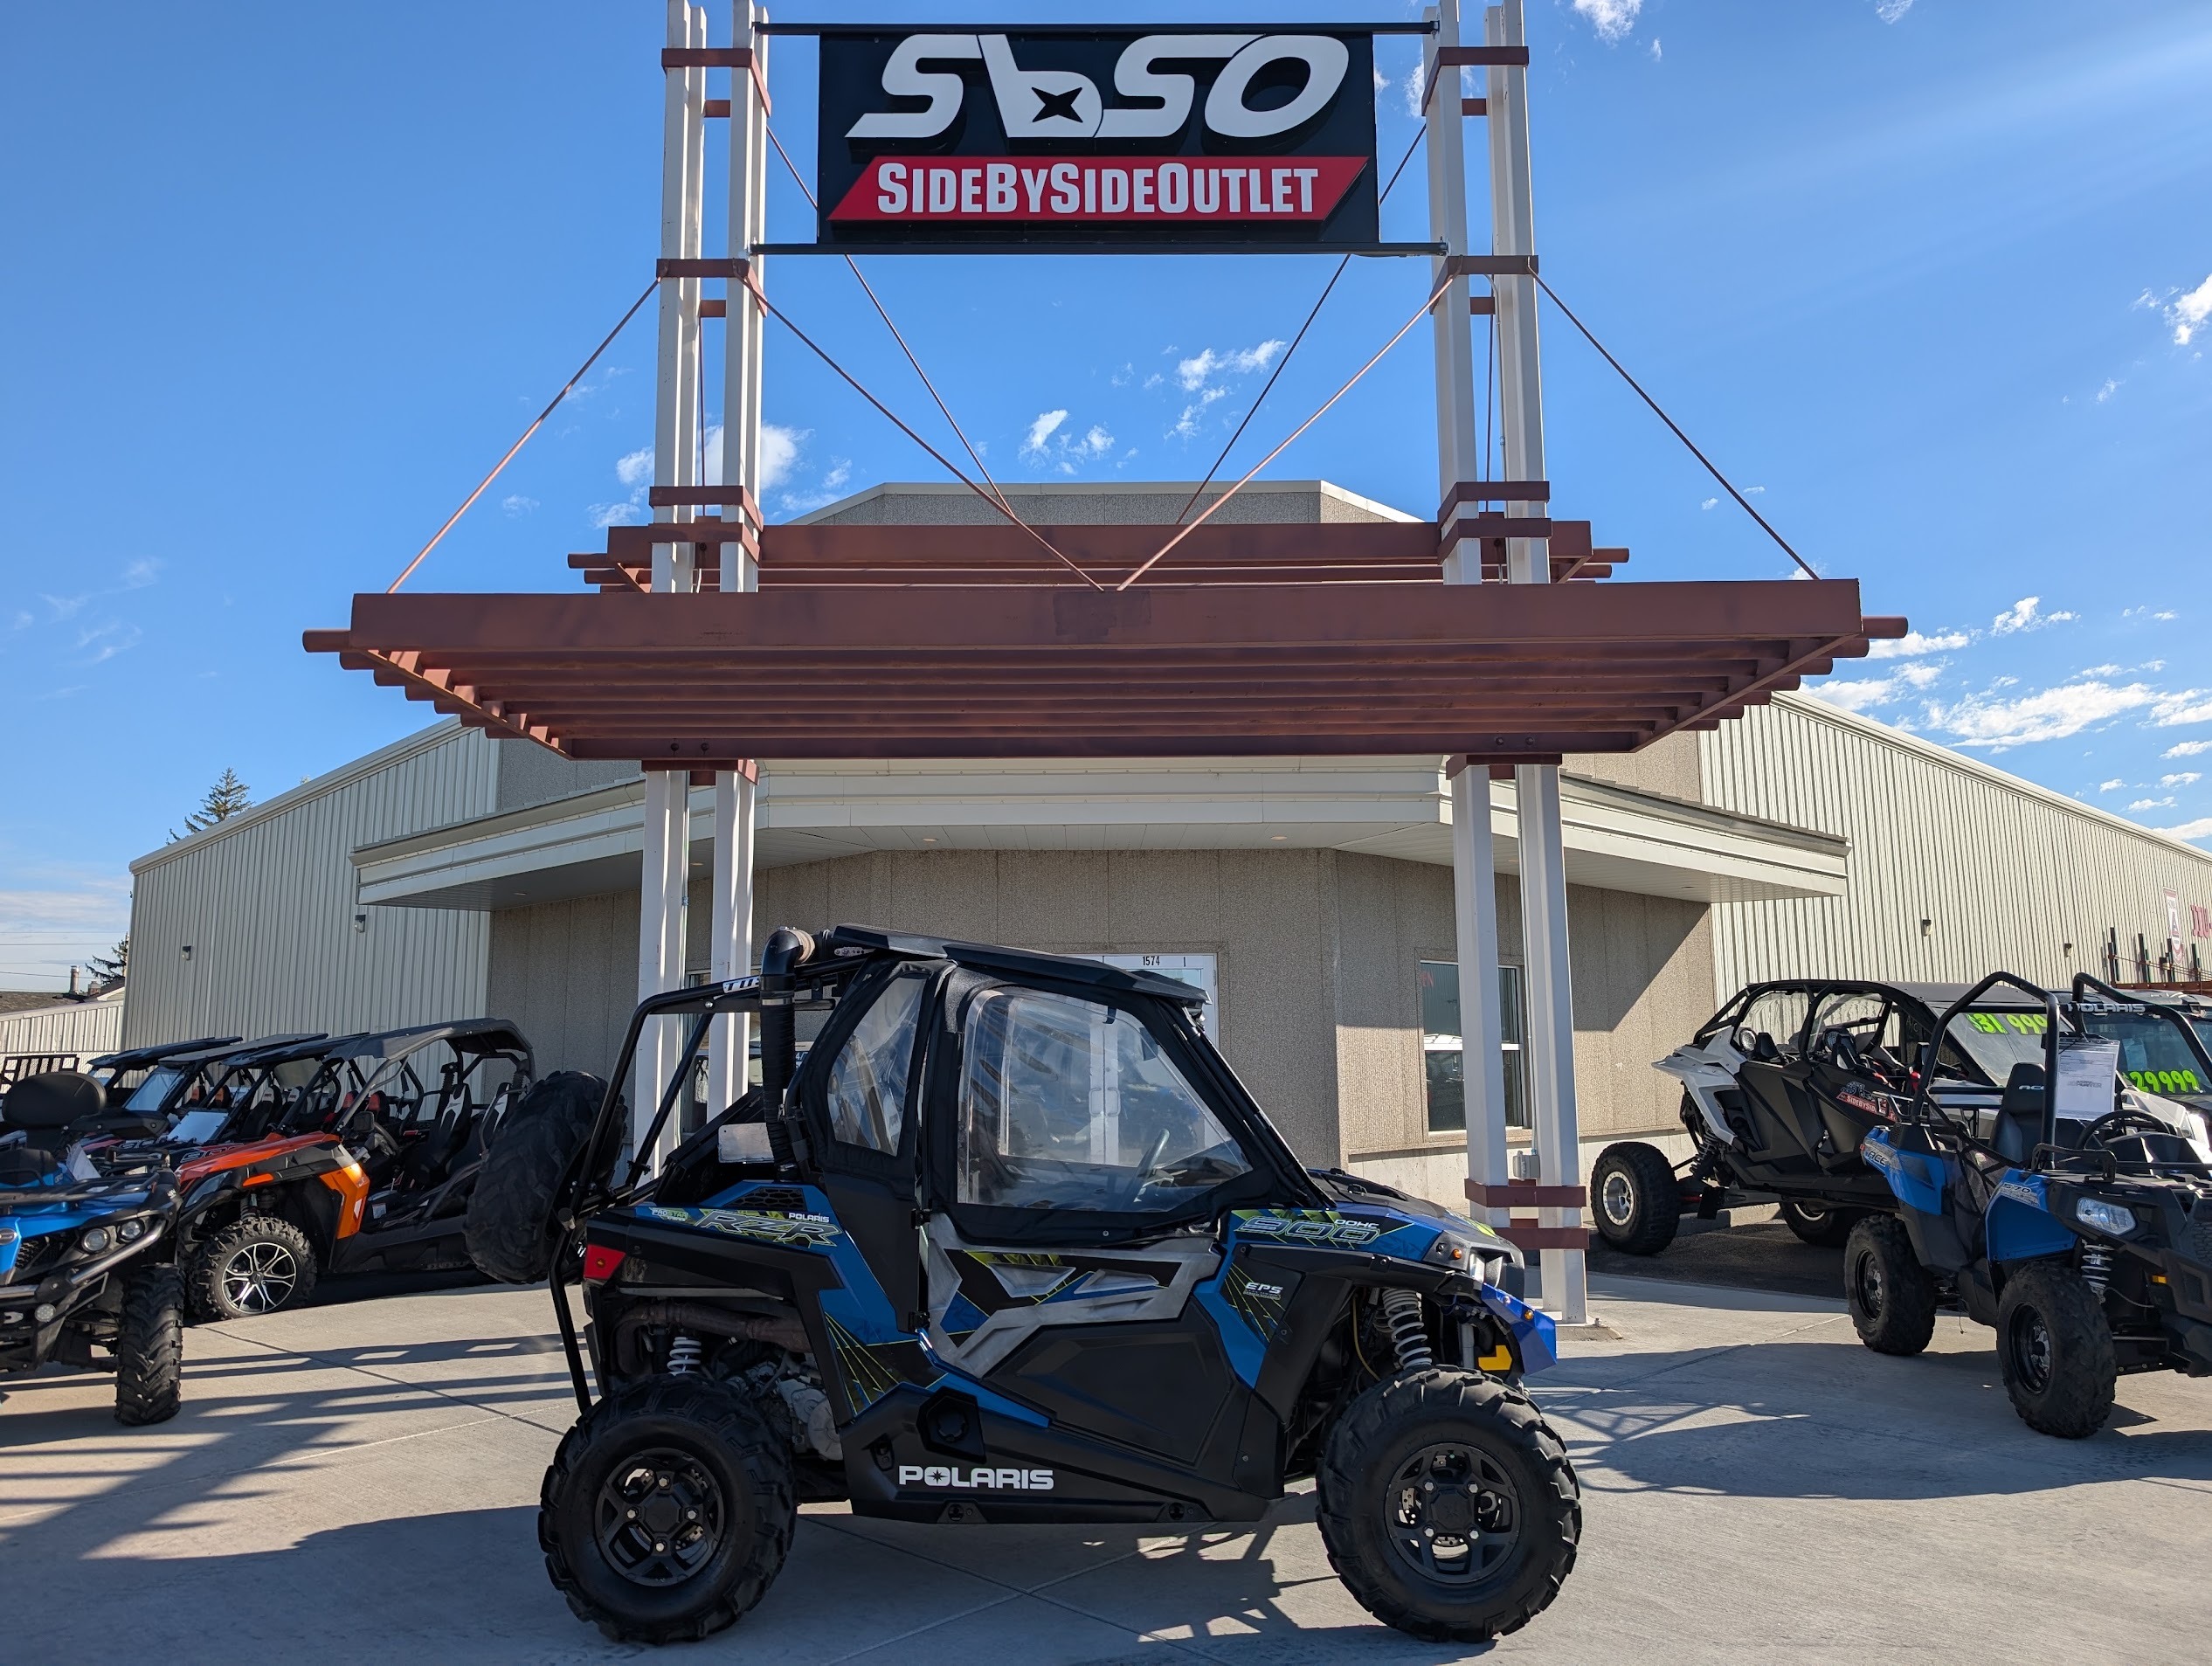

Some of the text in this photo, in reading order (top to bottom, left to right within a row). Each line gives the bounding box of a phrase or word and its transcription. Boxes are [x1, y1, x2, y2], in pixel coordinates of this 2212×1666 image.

[1143, 956, 1160, 966] 1574
[1868, 1151, 1887, 1166] ACE
[2002, 1183, 2031, 1194] 570
[788, 1212, 830, 1223] POLARIS
[695, 1210, 842, 1247] RZR
[1235, 1216, 1380, 1244] 900
[1246, 1282, 1284, 1294] EPS
[899, 1465, 1054, 1490] POLARIS
